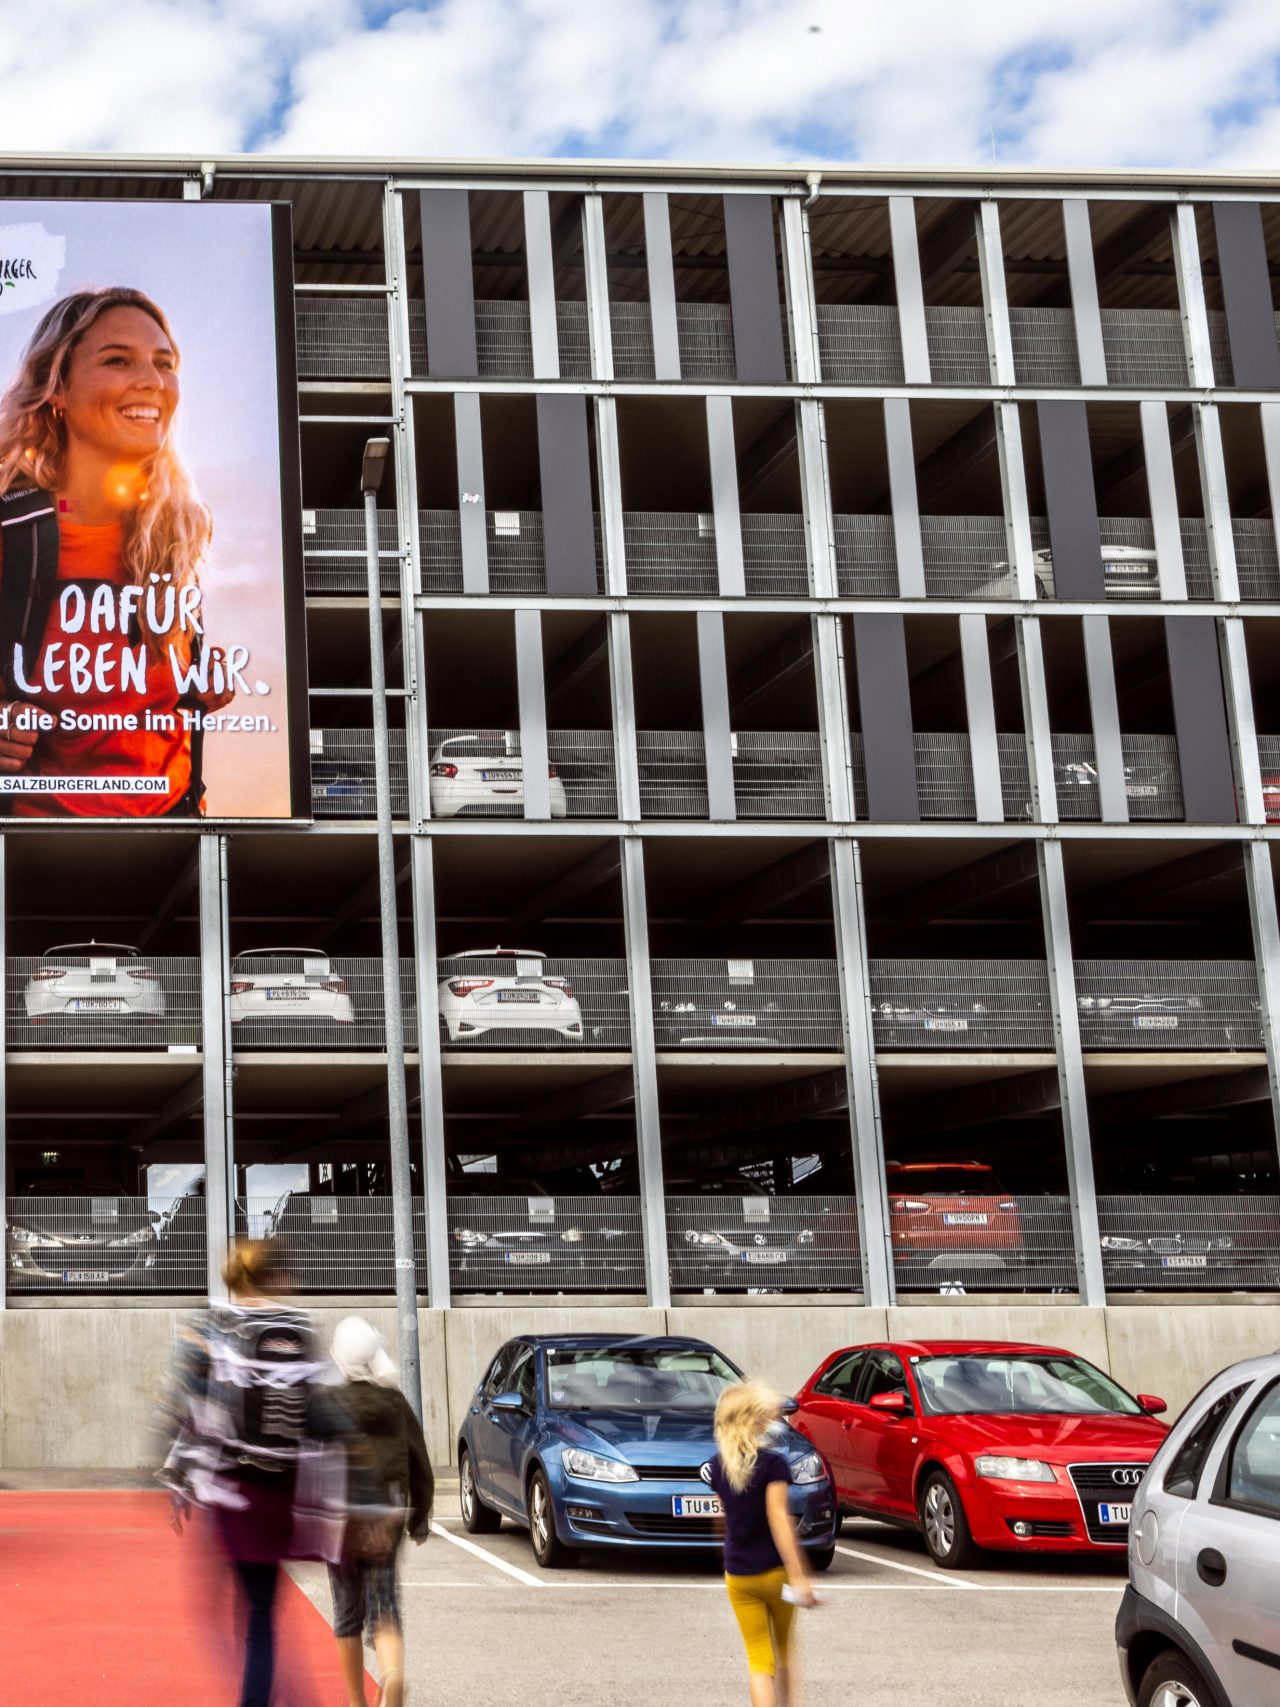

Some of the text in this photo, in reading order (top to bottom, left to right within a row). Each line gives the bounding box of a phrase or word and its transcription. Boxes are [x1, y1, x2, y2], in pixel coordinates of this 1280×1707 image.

[59, 572, 204, 635] DAFÜR
[13, 642, 147, 695] LEBEN
[16, 708, 54, 731] die
[60, 709, 138, 731] Sonne
[145, 709, 175, 731] im
[183, 709, 278, 732] Herzen.
[685, 1500, 702, 1513] TU
[1111, 1507, 1129, 1520] TU
